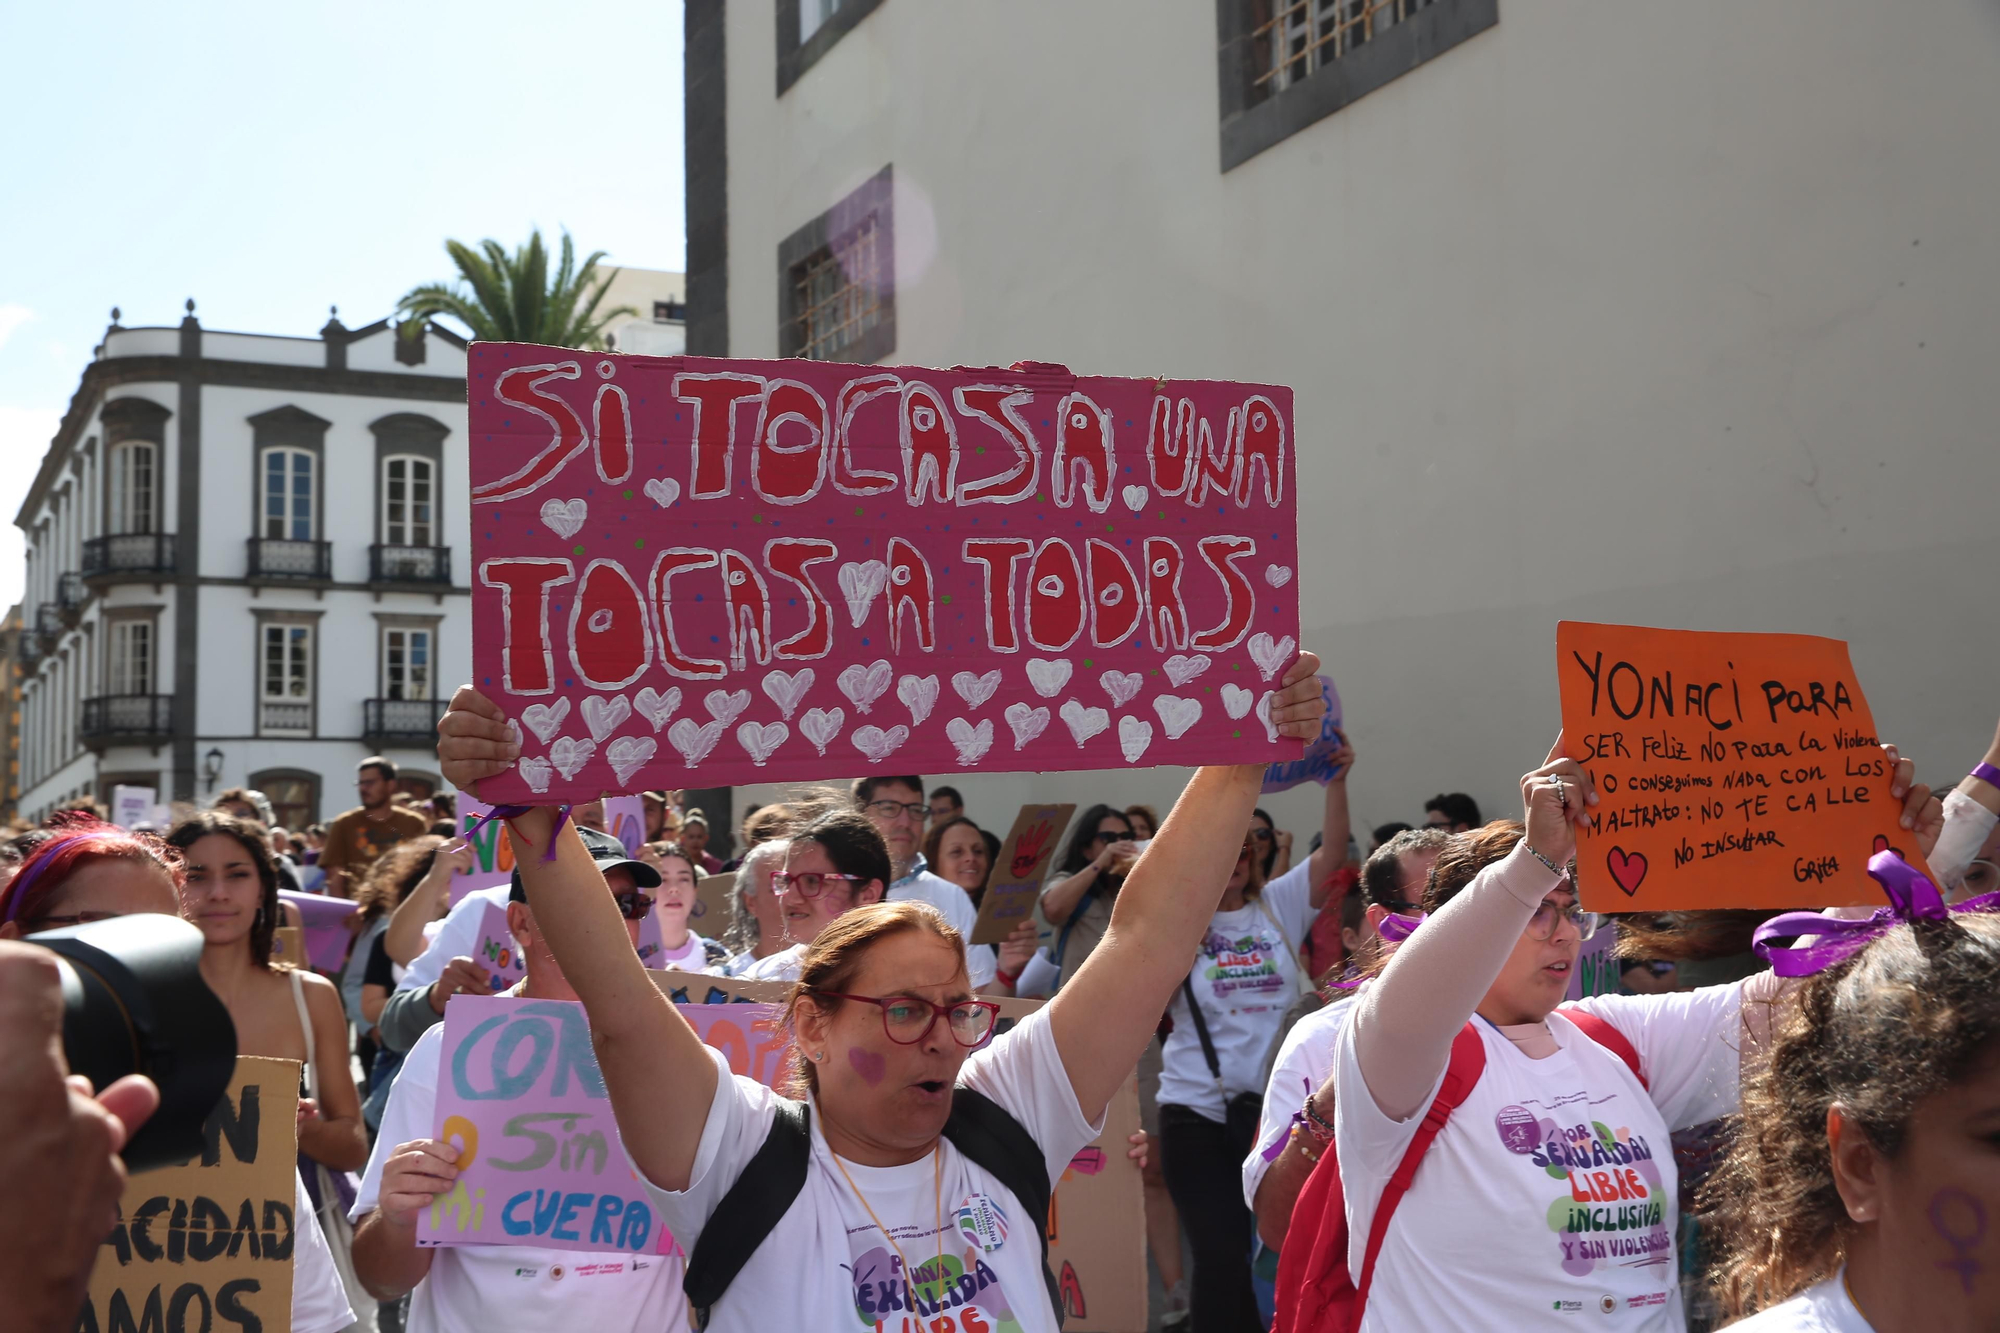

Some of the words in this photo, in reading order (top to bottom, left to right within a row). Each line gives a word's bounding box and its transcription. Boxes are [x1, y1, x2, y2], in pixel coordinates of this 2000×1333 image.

[1147, 394, 1285, 509] UNA
[479, 537, 838, 696] TOCAS
[886, 537, 934, 655] A
[1577, 732, 1631, 764] SER
[1642, 730, 1692, 763] Feliz
[1700, 731, 1726, 763] NO
[1845, 756, 1884, 777] LOS
[1701, 797, 1724, 825] NO
[1735, 795, 1768, 822] TE
[1674, 837, 1694, 869] NO
[1567, 1168, 1648, 1203] LIBRE
[1562, 1241, 1574, 1260] Y
[1580, 1240, 1607, 1260] SIN
